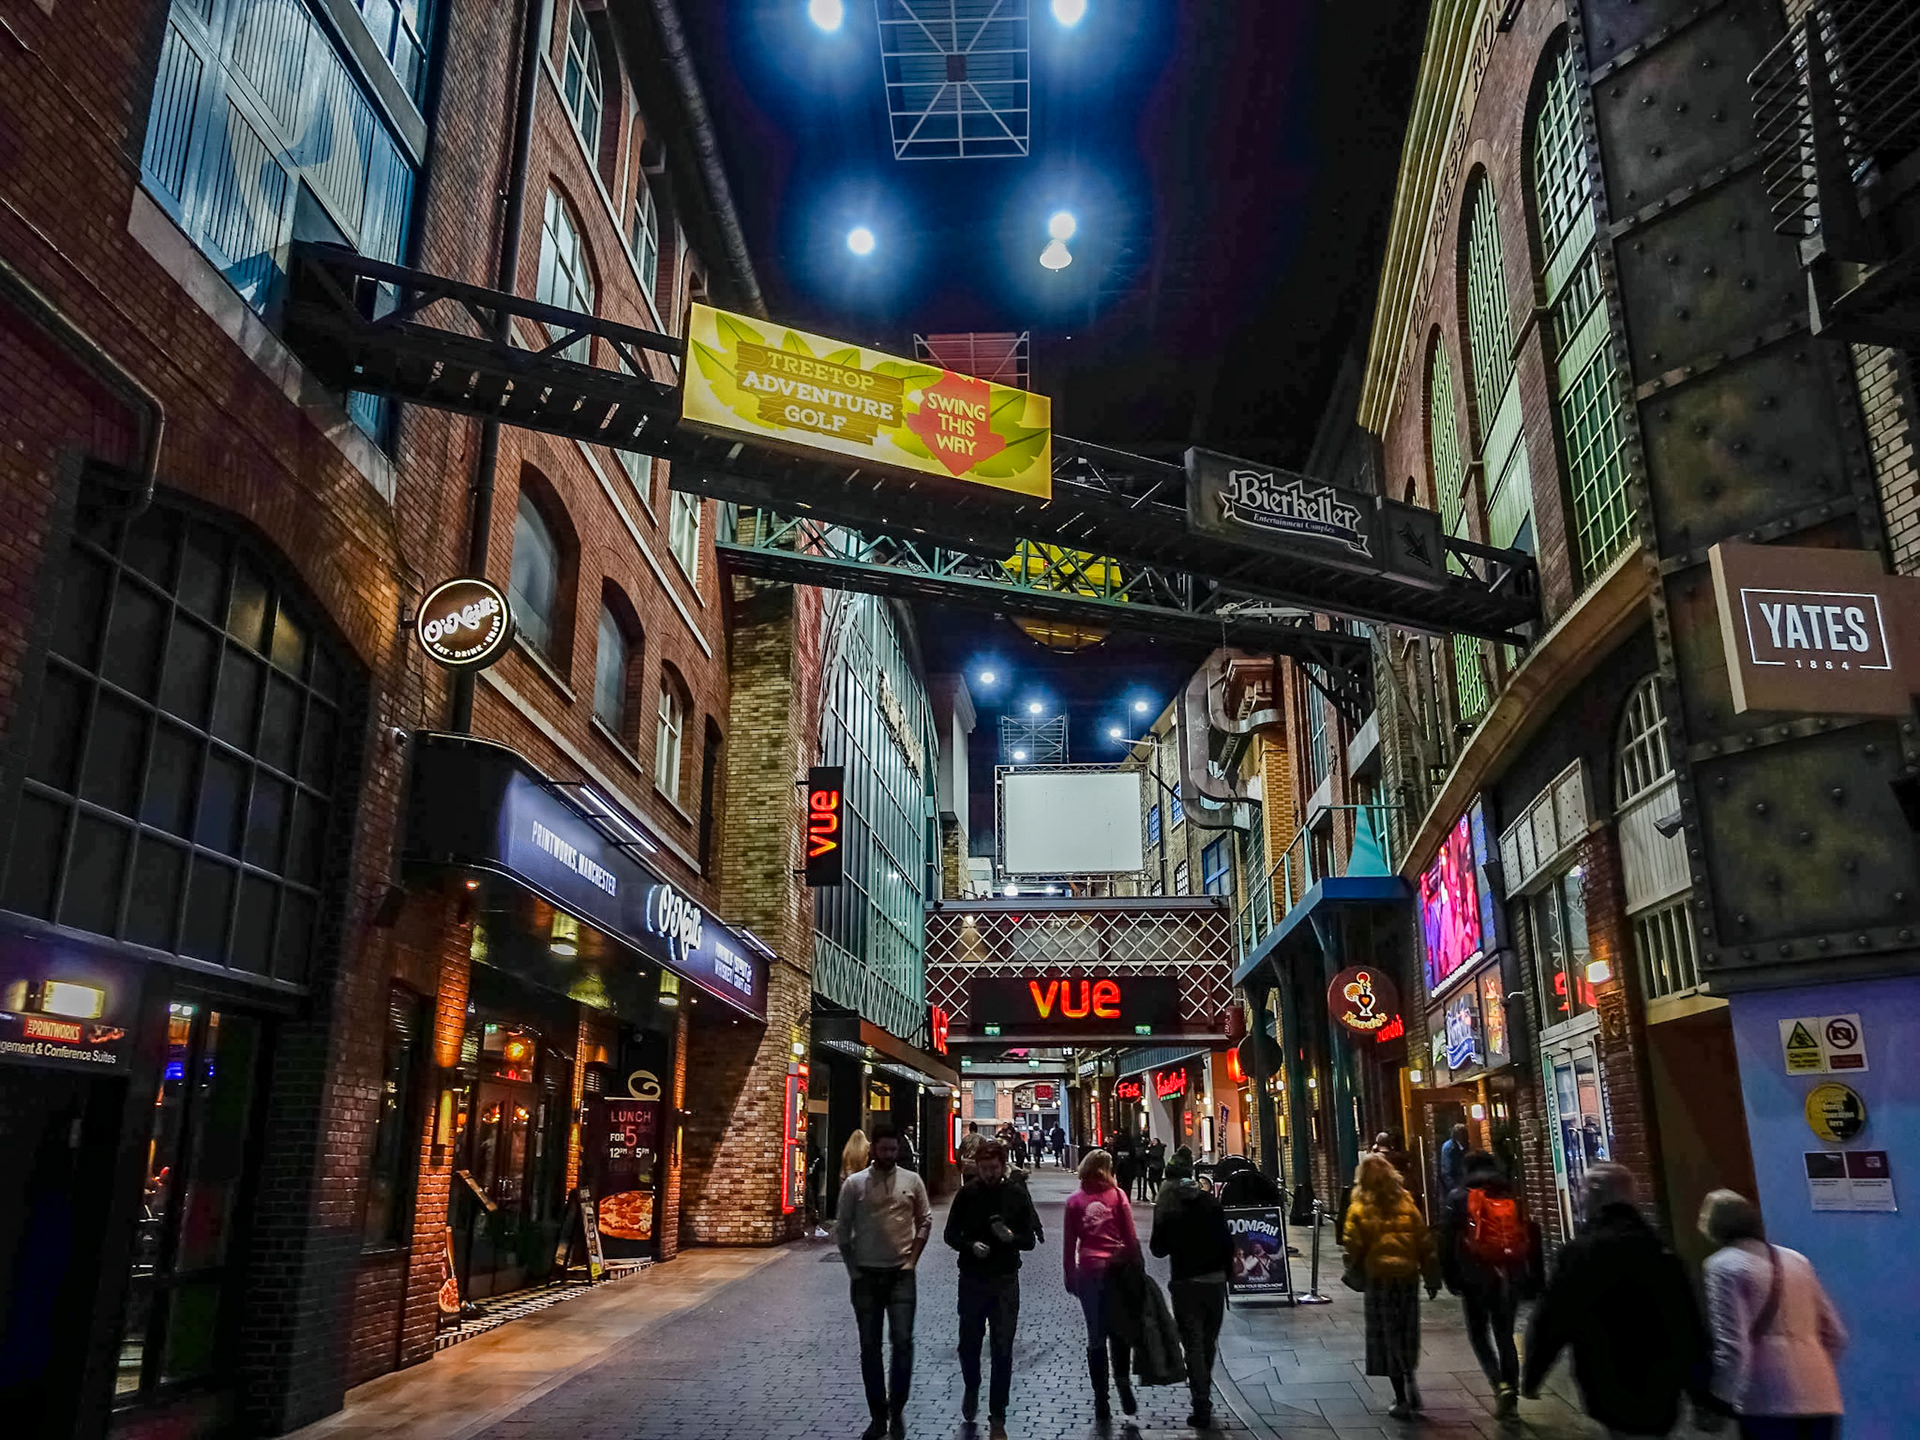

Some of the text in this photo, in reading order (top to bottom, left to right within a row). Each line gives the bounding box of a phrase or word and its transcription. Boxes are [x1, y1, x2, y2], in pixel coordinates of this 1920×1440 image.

[767, 351, 875, 392] TREETOP
[742, 370, 894, 421] ADVENTURE
[926, 391, 987, 421] SWING
[784, 404, 848, 433] GOLF
[937, 411, 976, 438] THIS
[935, 432, 979, 457] WAY
[1239, 476, 1355, 531] Bierkeller
[1253, 512, 1336, 534] Entertainment Complex
[433, 615, 501, 658] EAT DRINK ENJOY
[1758, 601, 1870, 653] YATES
[1794, 659, 1850, 671] 1884
[578, 852, 617, 897] MANCHESTER
[32, 1019, 81, 1041] PRINTWORKS
[35, 1042, 44, 1055] &
[44, 1044, 91, 1061] Conference
[92, 1049, 117, 1064] Suites
[610, 1110, 652, 1123] LUNCH
[610, 1132, 625, 1142] FOR
[610, 1147, 650, 1159] 12PM 5PM
